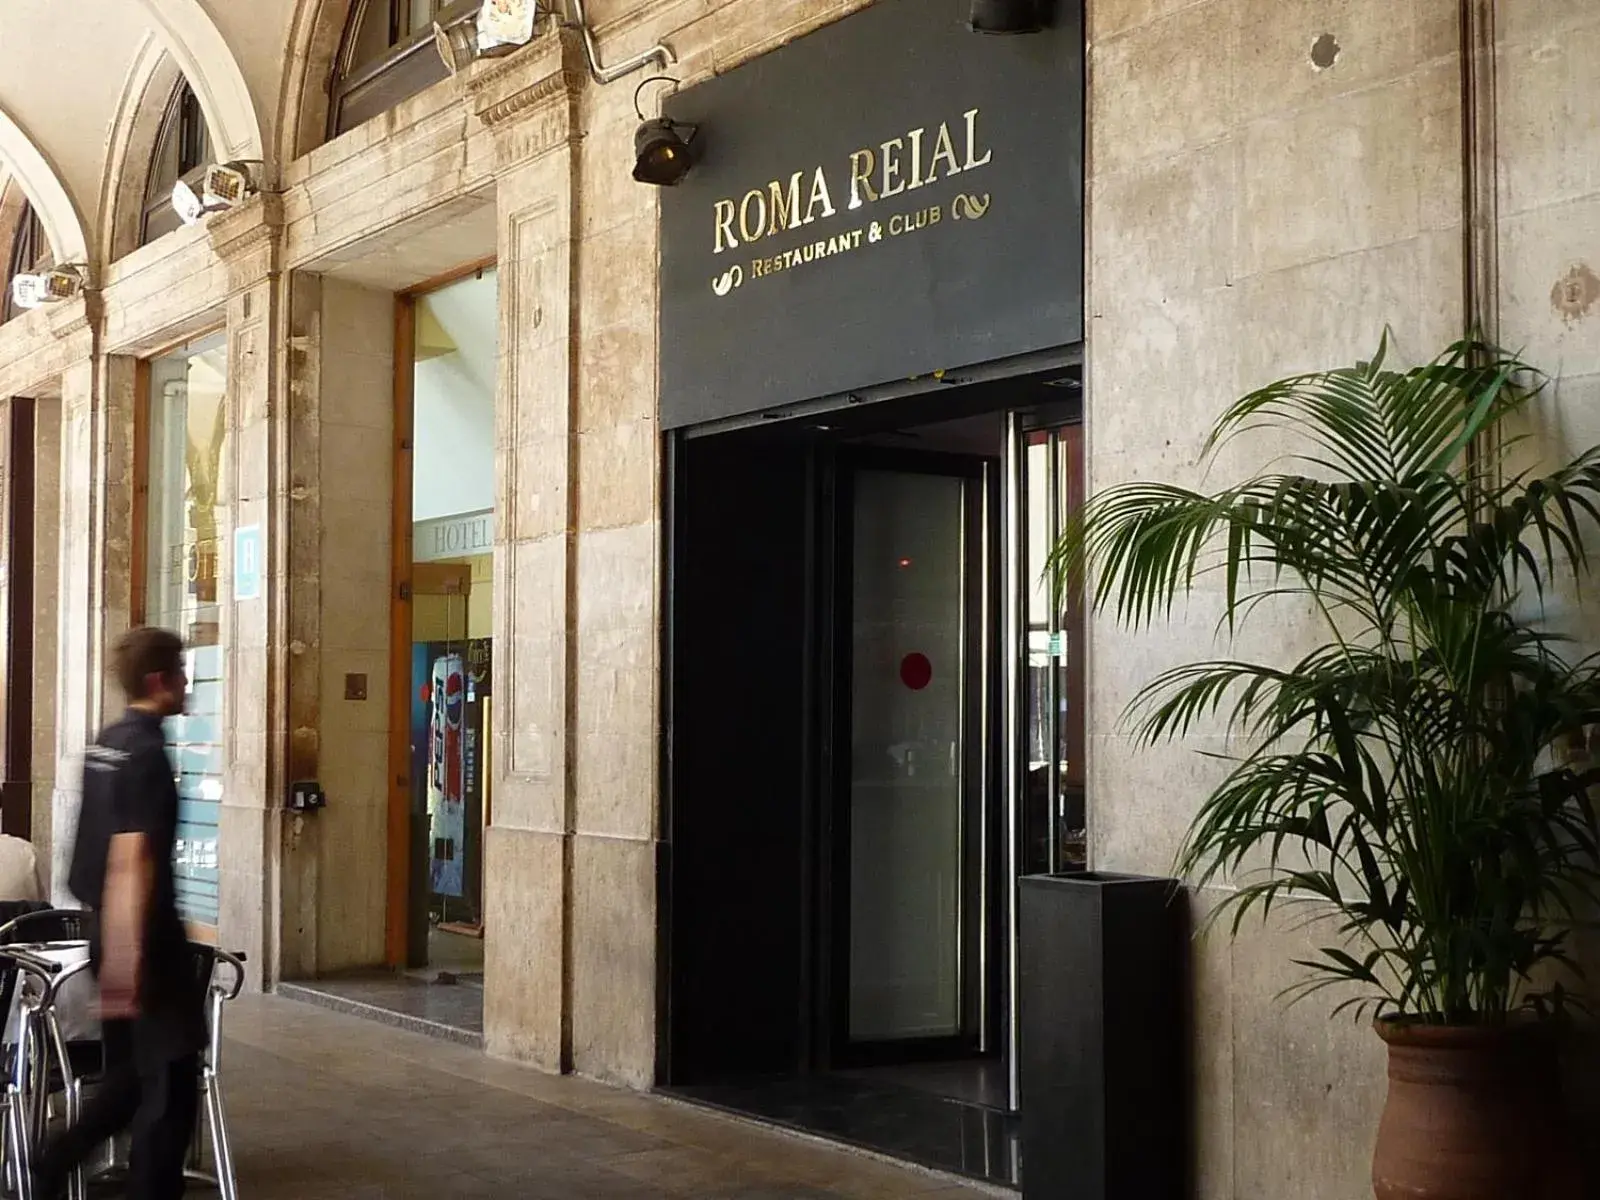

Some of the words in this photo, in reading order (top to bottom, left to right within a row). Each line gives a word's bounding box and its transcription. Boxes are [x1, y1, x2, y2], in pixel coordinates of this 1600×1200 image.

[712, 165, 837, 254] ROMA
[847, 107, 993, 211] REIAL
[751, 229, 864, 280] RESTAURANT
[867, 220, 883, 243] &
[888, 205, 944, 237] CLUB
[434, 519, 491, 554] HOTEL
[433, 676, 445, 793] PEPSI
